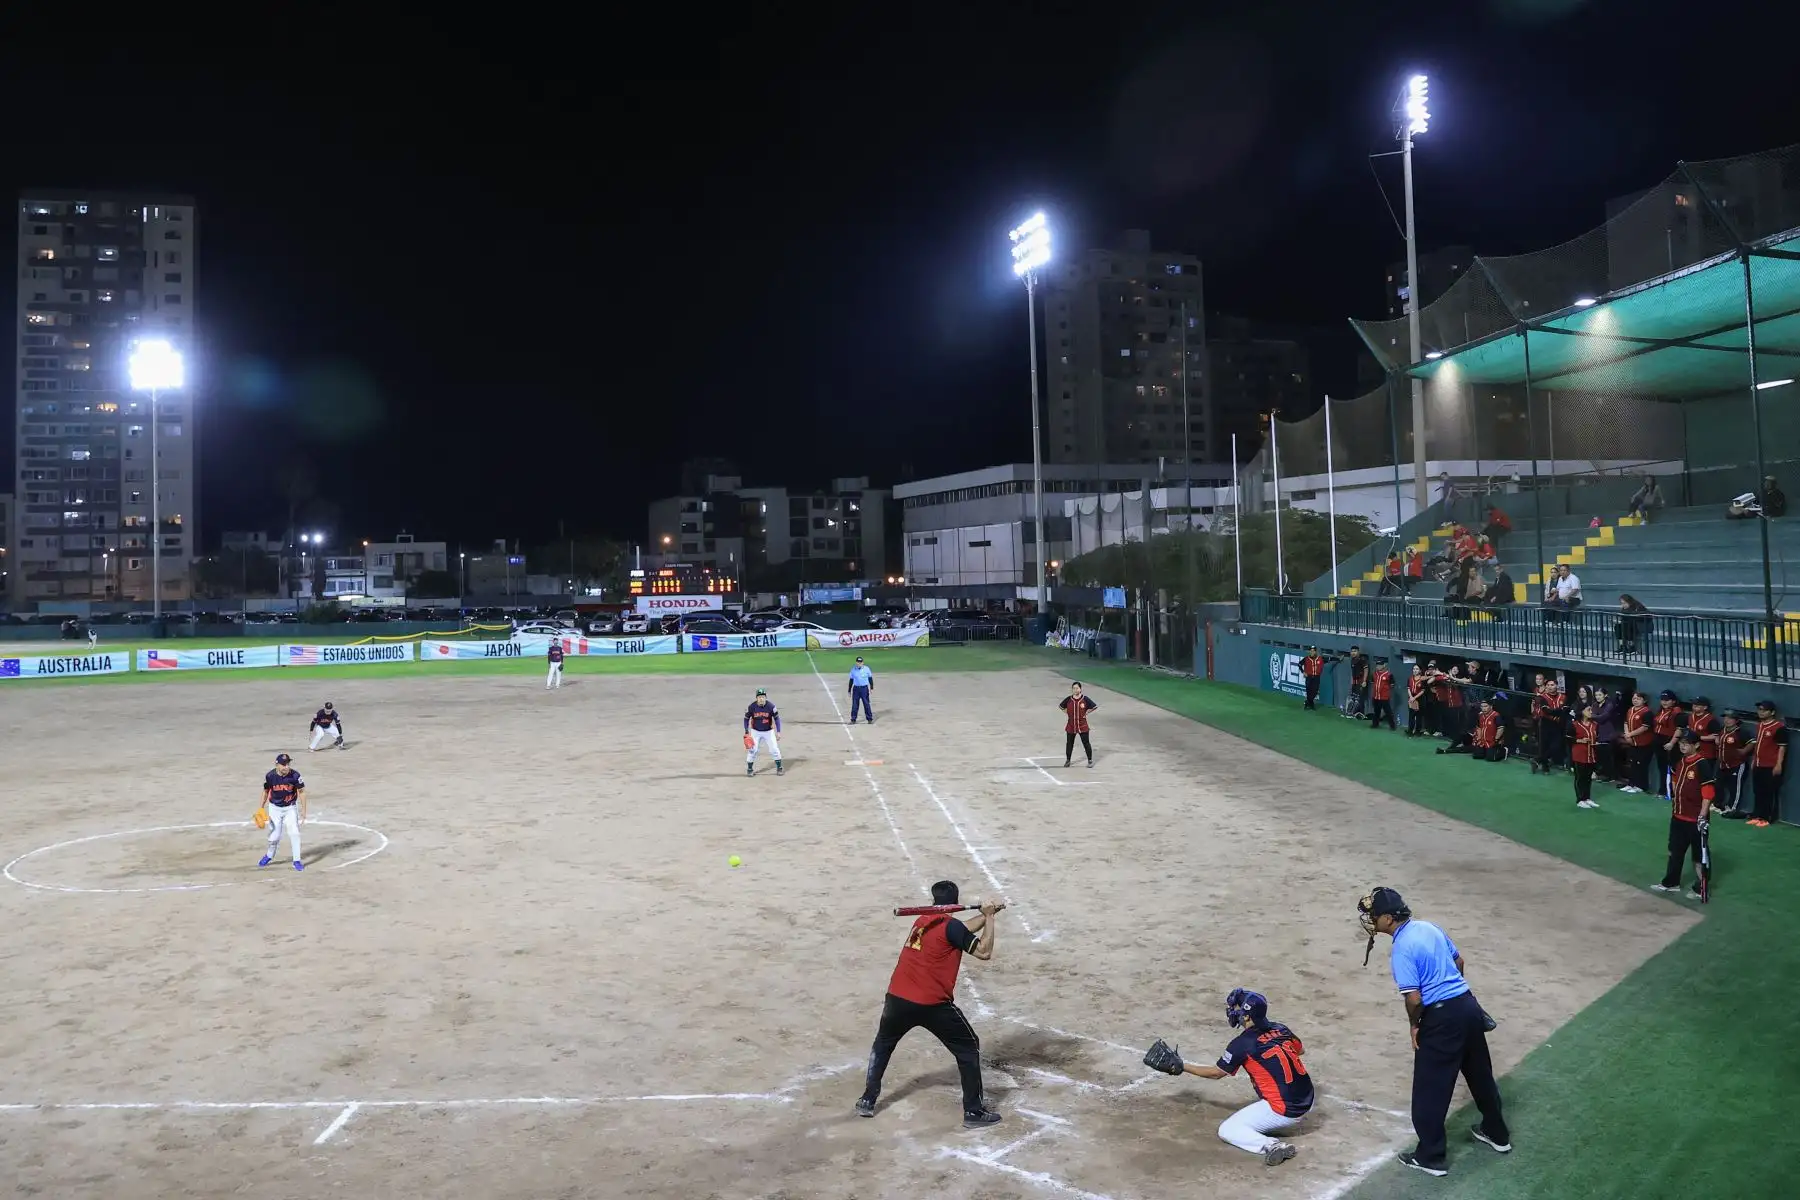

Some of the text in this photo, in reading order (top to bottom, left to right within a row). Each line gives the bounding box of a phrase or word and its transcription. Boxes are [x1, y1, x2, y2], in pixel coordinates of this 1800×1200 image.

[648, 599, 710, 609] HONDA
[616, 637, 645, 653] PERÚ
[741, 634, 778, 648] ASEAN
[856, 633, 897, 643] MIRAY
[323, 645, 404, 661] ESTADOS UNIDOS
[485, 641, 521, 656] JAPÓN
[38, 656, 112, 674] AUSTRALIA
[208, 650, 244, 665] CHILE
